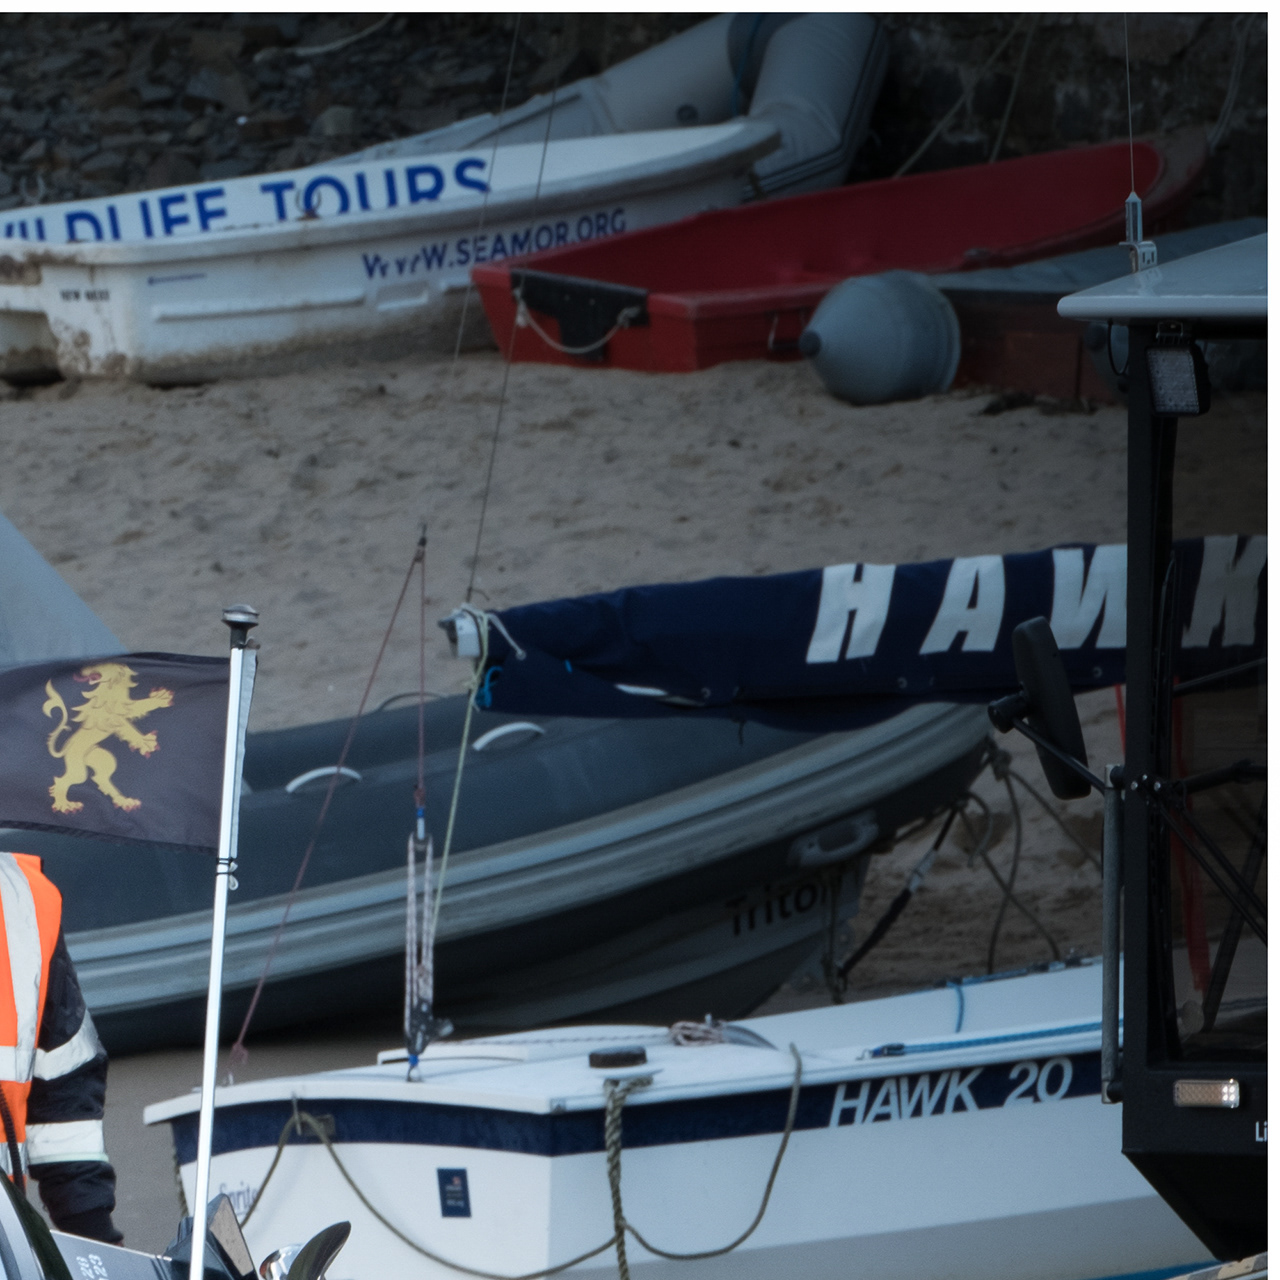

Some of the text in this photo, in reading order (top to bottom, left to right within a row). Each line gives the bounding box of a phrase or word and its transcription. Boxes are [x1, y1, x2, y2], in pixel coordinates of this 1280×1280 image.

[261, 157, 490, 222] TOURS
[827, 1055, 1073, 1128] HAWK 20
